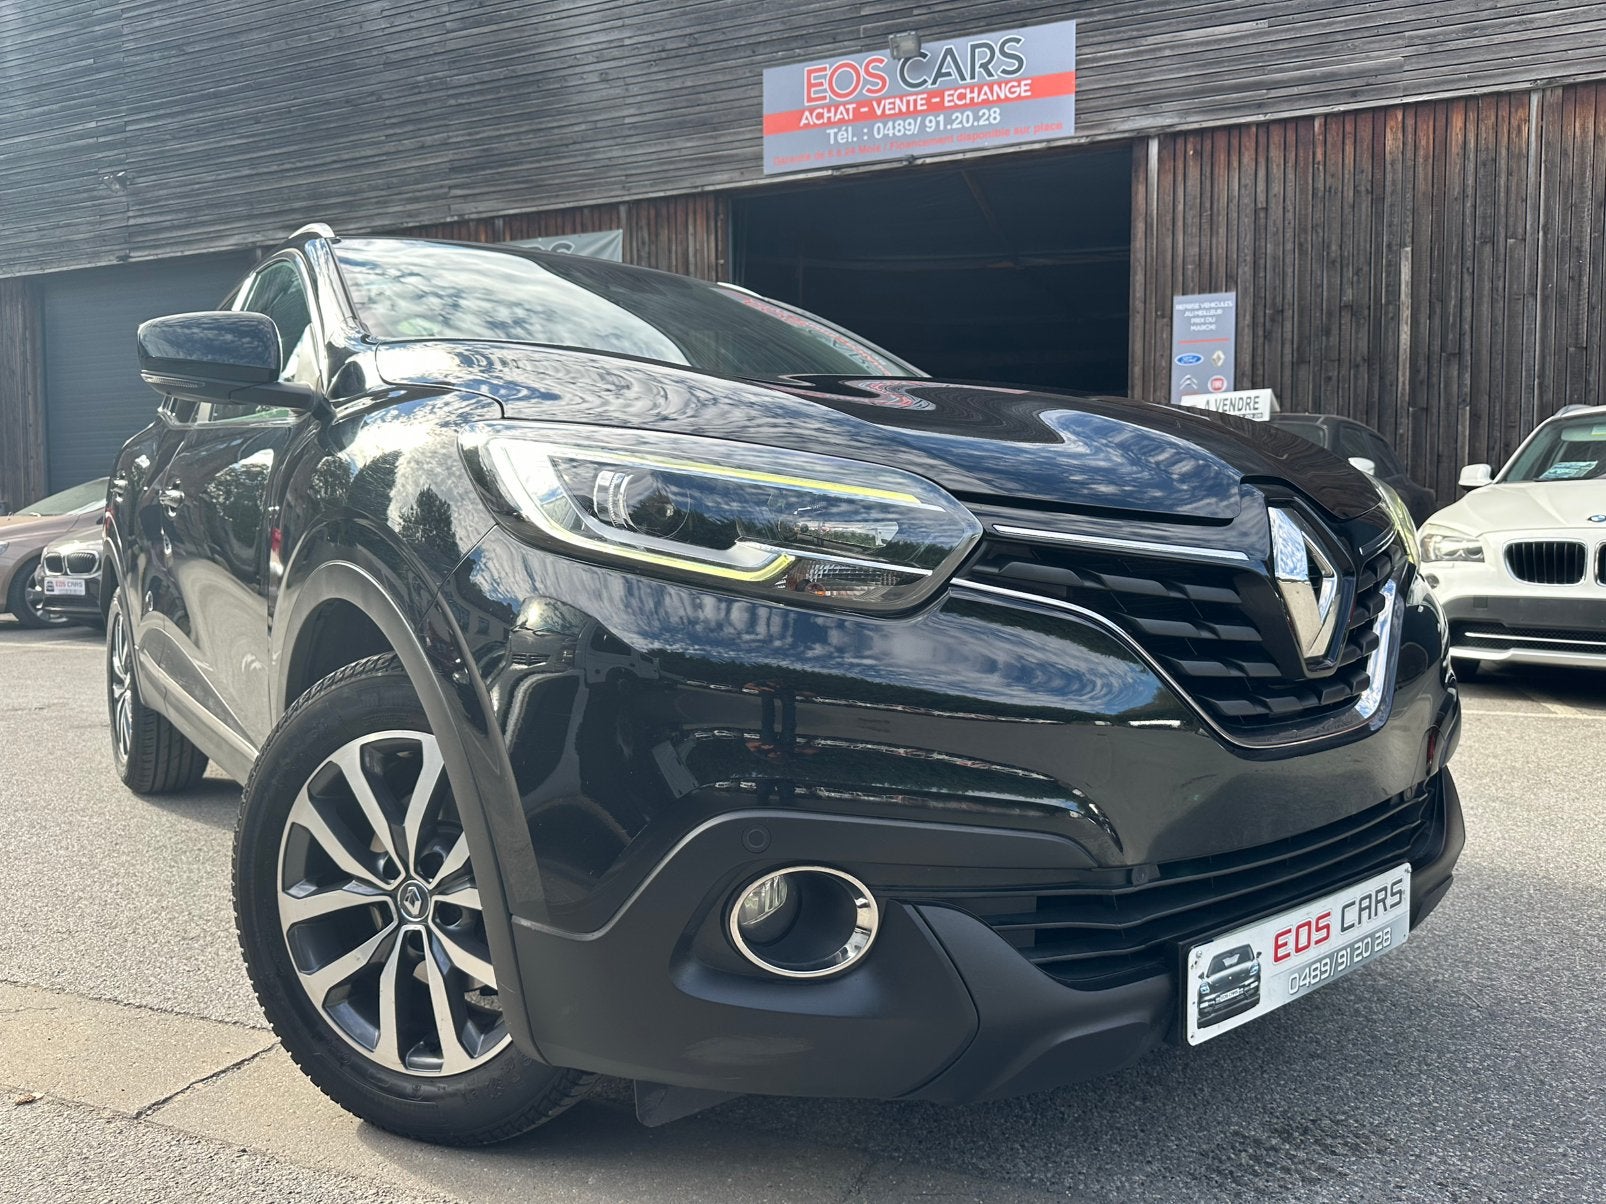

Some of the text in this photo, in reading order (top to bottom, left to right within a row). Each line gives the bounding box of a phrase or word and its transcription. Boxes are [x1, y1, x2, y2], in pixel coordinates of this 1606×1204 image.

[804, 35, 1026, 106] EOS CARS
[800, 105, 856, 127] ACHAT
[873, 94, 927, 116] VENTE
[944, 80, 1032, 107] ECHANGE
[826, 127, 857, 145] Tél.
[874, 117, 919, 139] 0489/
[925, 107, 1001, 132] 91.20.28
[890, 135, 954, 150] Financement
[957, 127, 1010, 143] disponible
[1014, 126, 1030, 136] sur
[1033, 121, 1063, 135] place
[1215, 396, 1260, 412] VENDRE
[1273, 878, 1403, 963] EOS CARS
[1353, 937, 1371, 962] 20
[1374, 927, 1392, 952] 28
